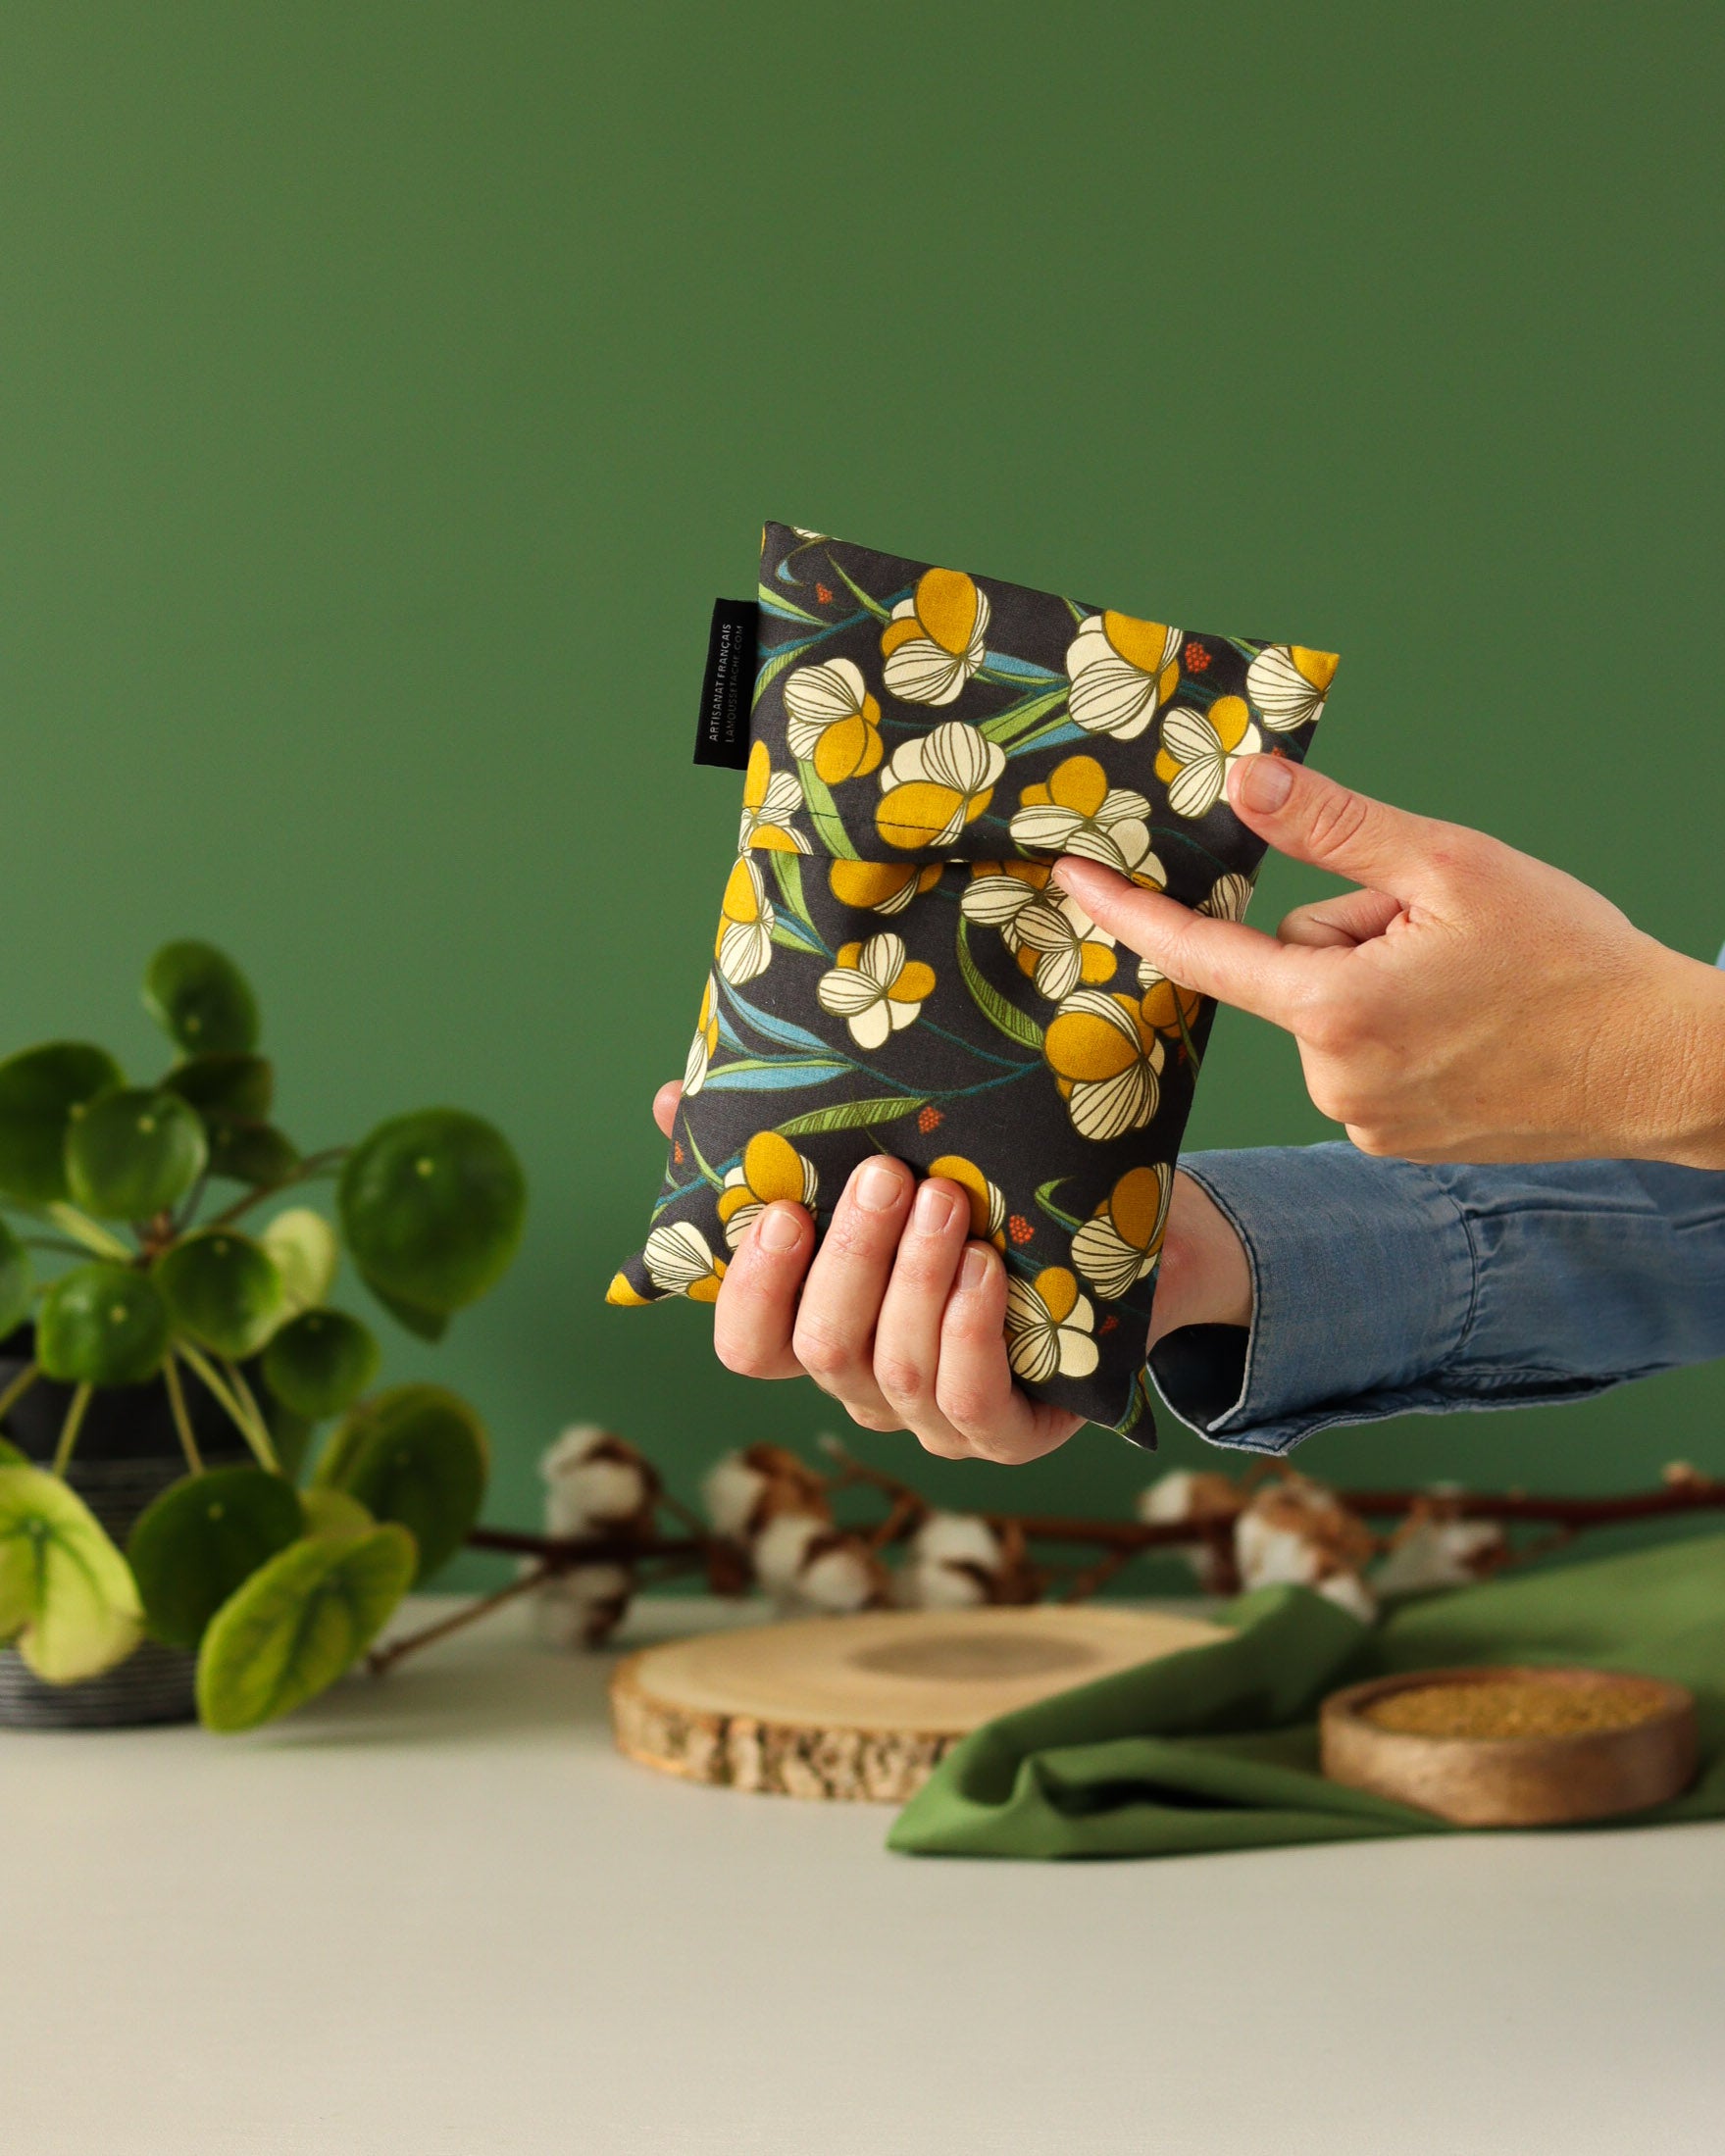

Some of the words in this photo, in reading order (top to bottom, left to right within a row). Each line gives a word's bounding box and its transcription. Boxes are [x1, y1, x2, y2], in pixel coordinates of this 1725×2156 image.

[709, 681, 725, 741] ARTISANAT
[717, 624, 732, 678] FRANÇAIS
[725, 626, 743, 743] LAMOUSSETACHE.COM
